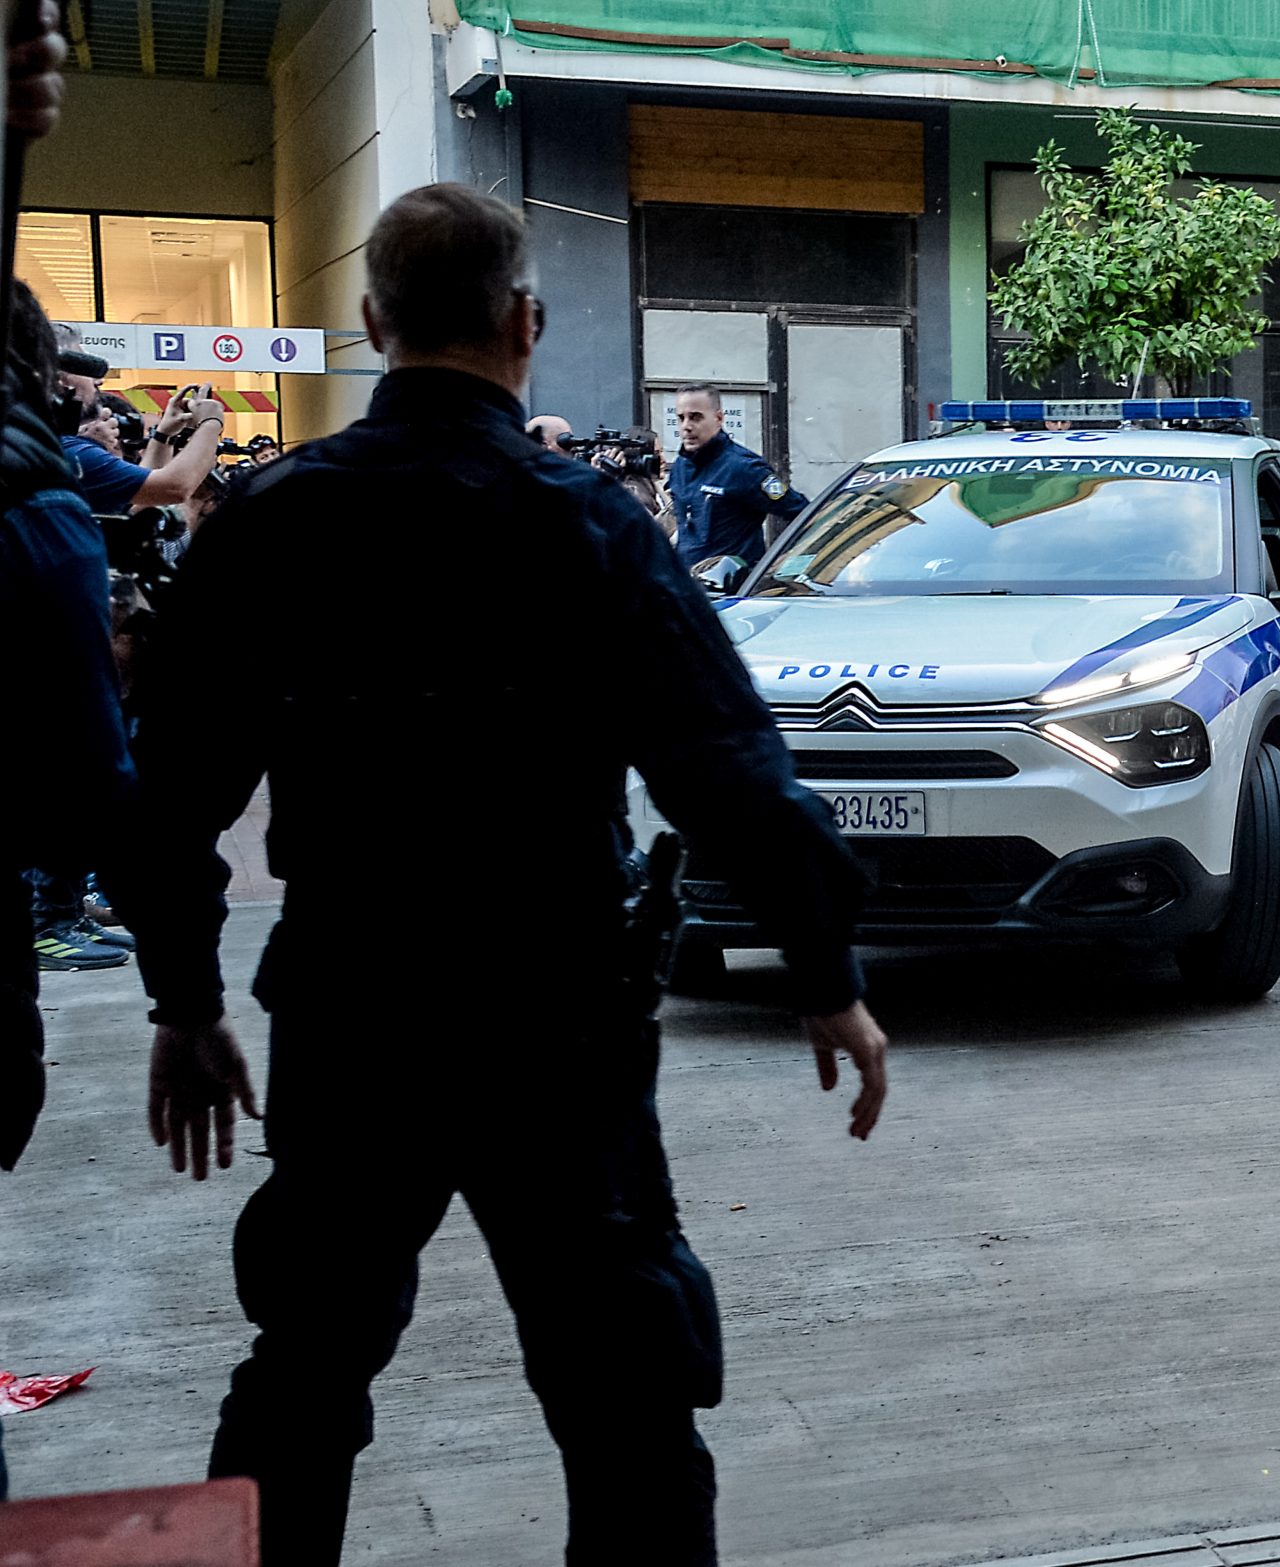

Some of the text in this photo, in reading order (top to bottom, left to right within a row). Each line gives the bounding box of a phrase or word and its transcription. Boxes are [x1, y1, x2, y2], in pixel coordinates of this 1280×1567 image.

[160, 336, 179, 358] P
[845, 458, 1221, 489] ΕΛΛΗΝΙΚΗ ΑΣΤΥΝΟΜΙΑ
[778, 664, 941, 680] POLICE
